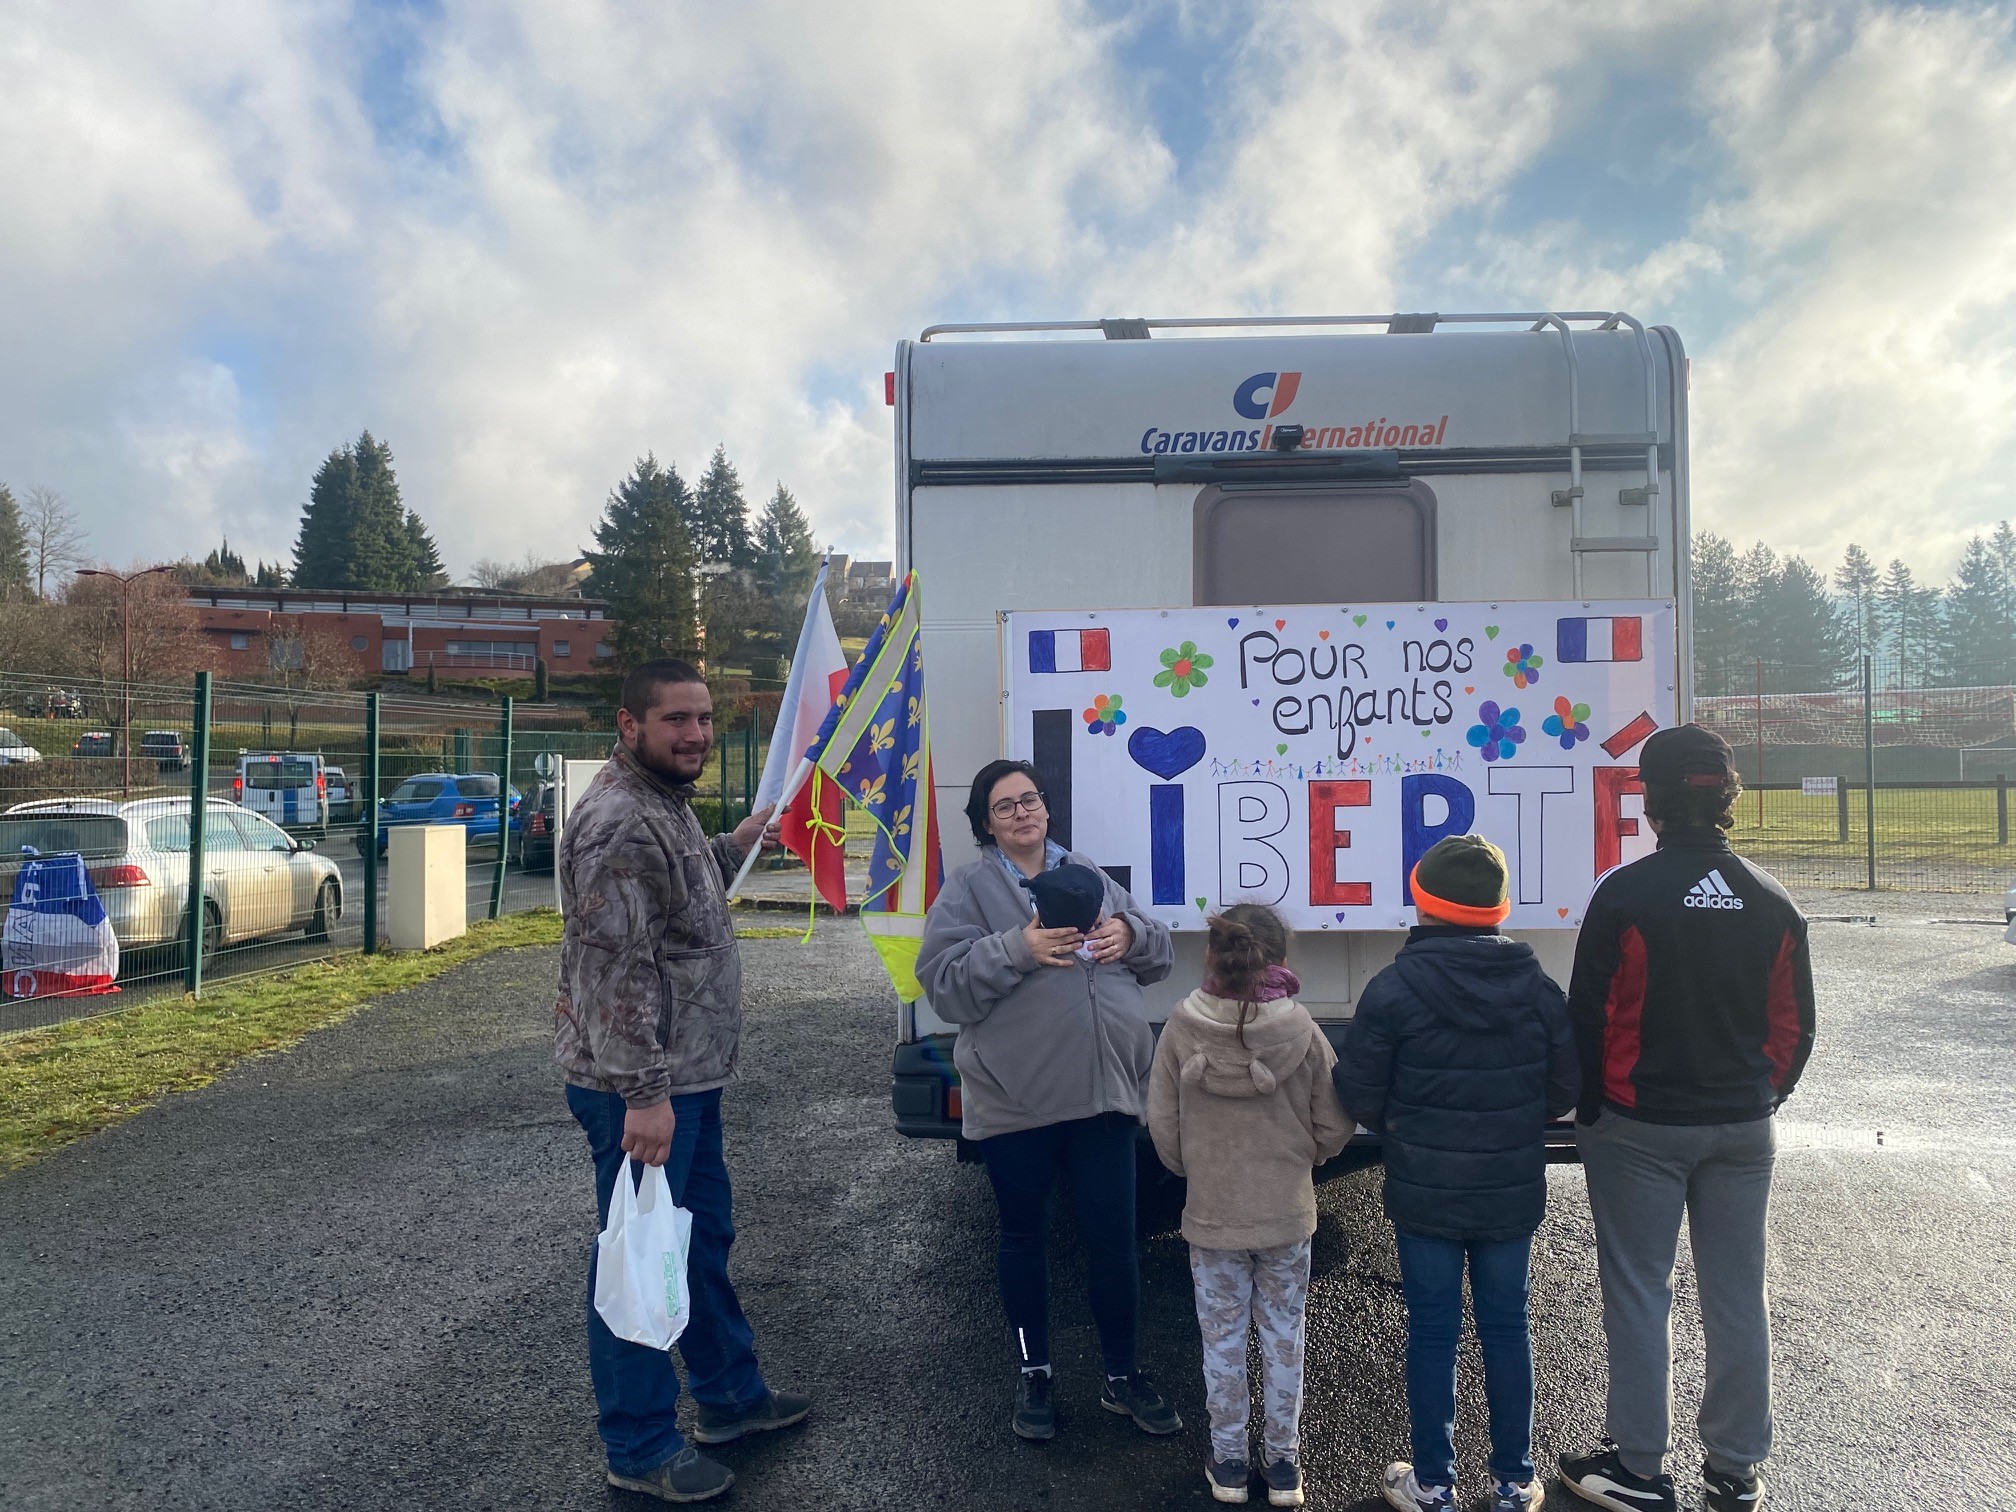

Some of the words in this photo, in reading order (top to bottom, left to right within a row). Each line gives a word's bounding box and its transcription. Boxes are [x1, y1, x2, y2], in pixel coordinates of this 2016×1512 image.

[1403, 637, 1475, 675] nos
[1272, 682, 1455, 760] enfants
[1683, 894, 1744, 910] adidas
